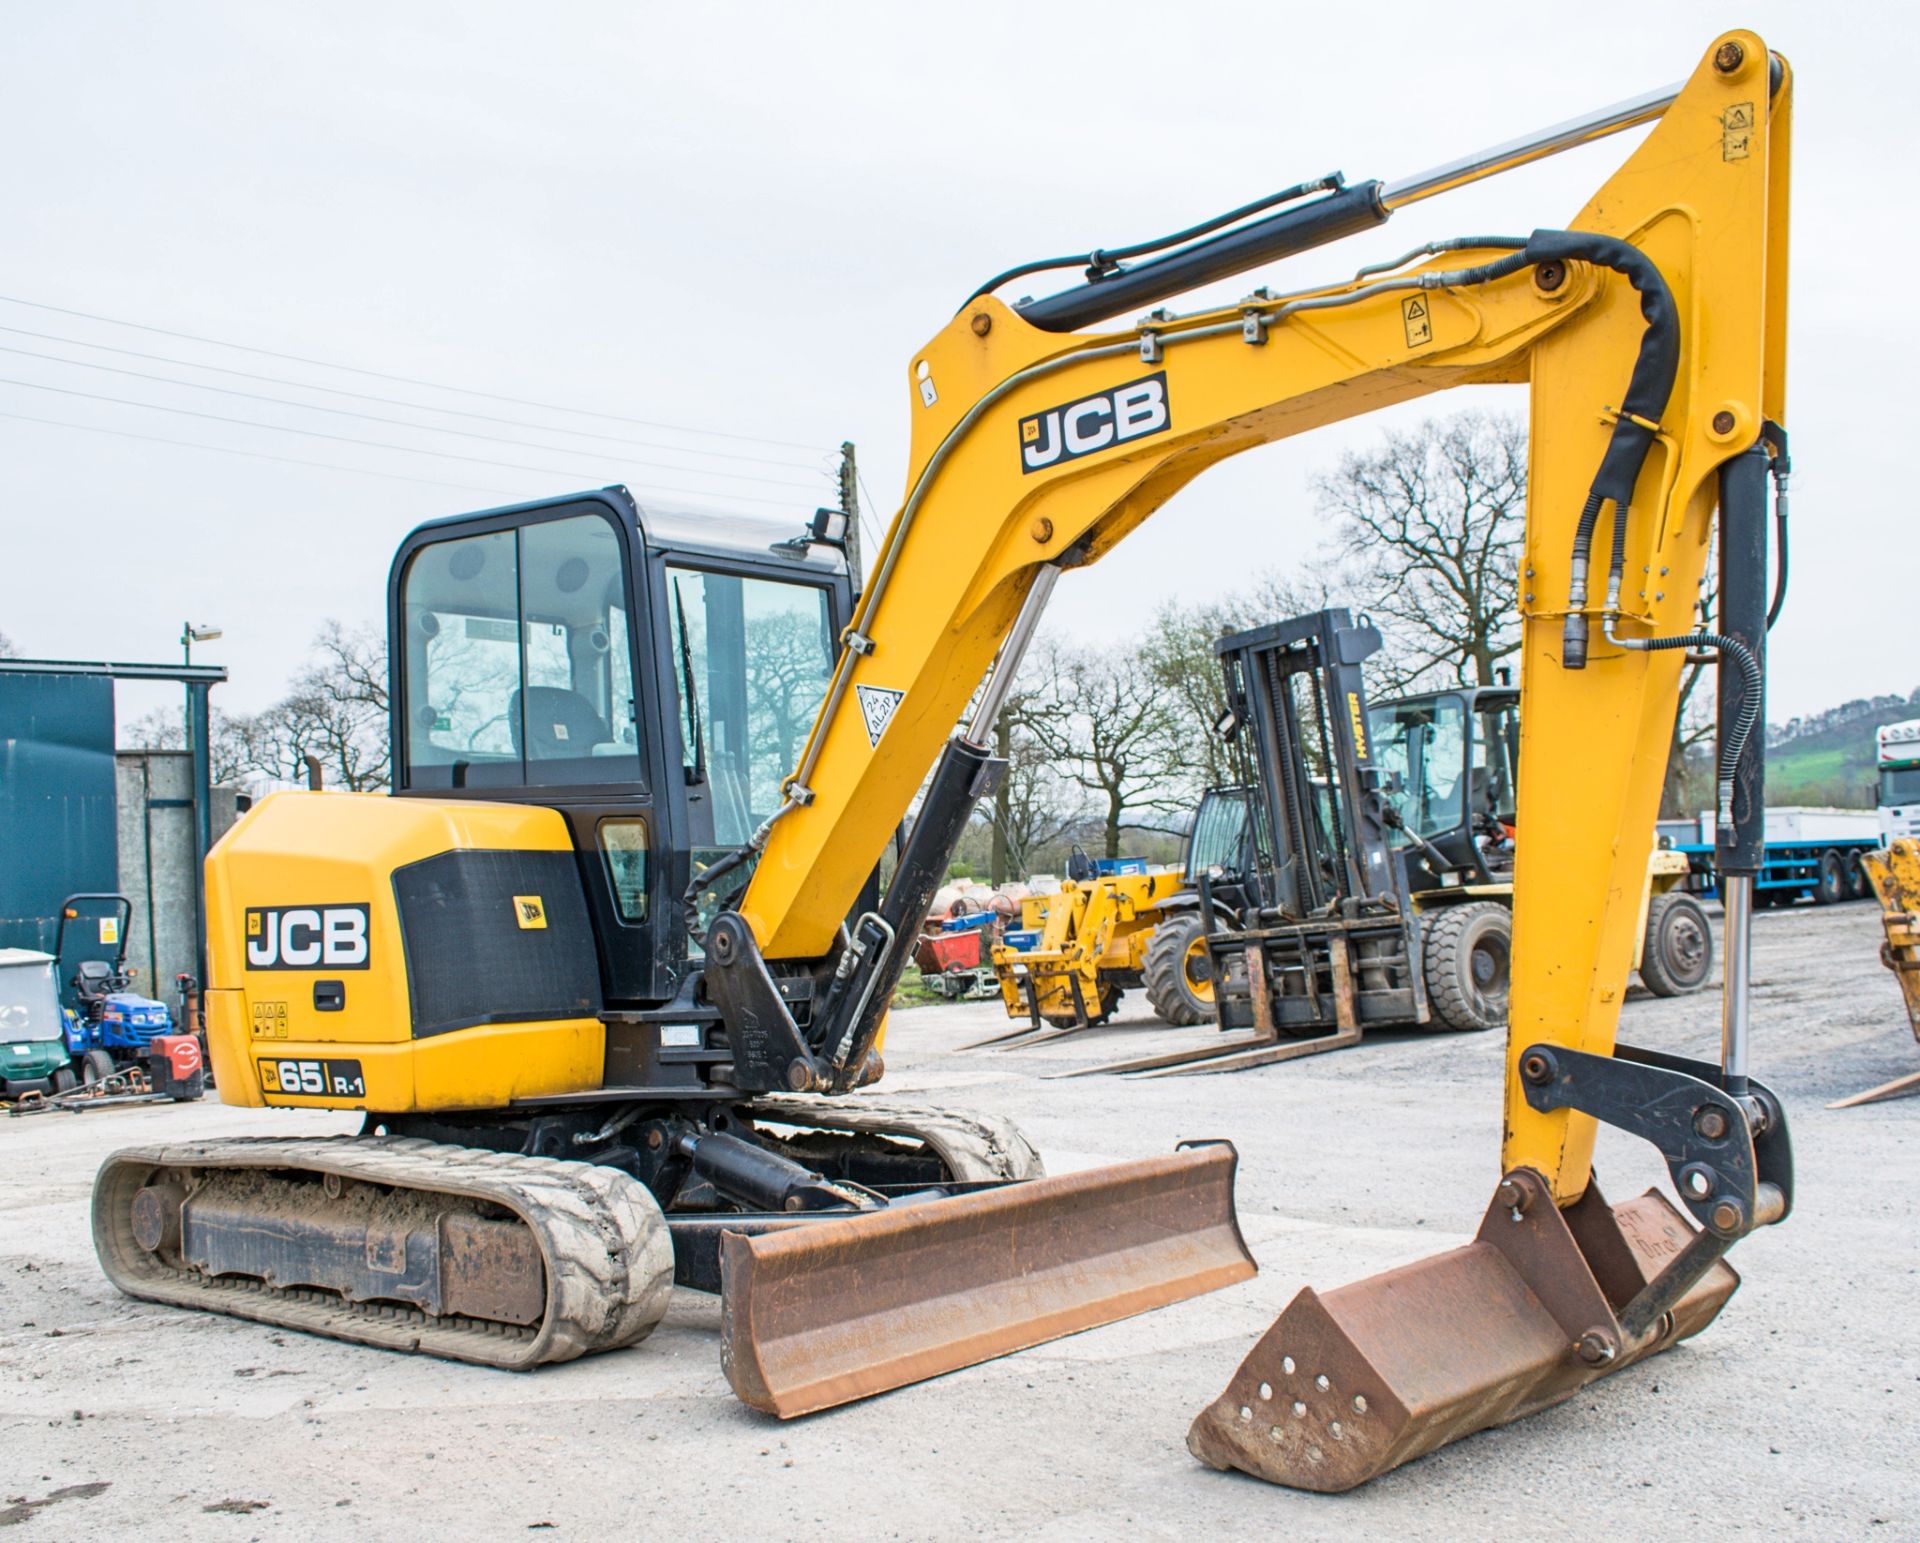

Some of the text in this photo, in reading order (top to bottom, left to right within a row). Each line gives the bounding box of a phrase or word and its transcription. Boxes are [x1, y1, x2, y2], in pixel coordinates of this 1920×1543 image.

[1024, 379, 1167, 468] JCB
[866, 694, 879, 713] 24
[1347, 691, 1368, 759] HYSTER
[247, 908, 368, 966] JCB
[277, 1060, 365, 1095] 65 R-1
